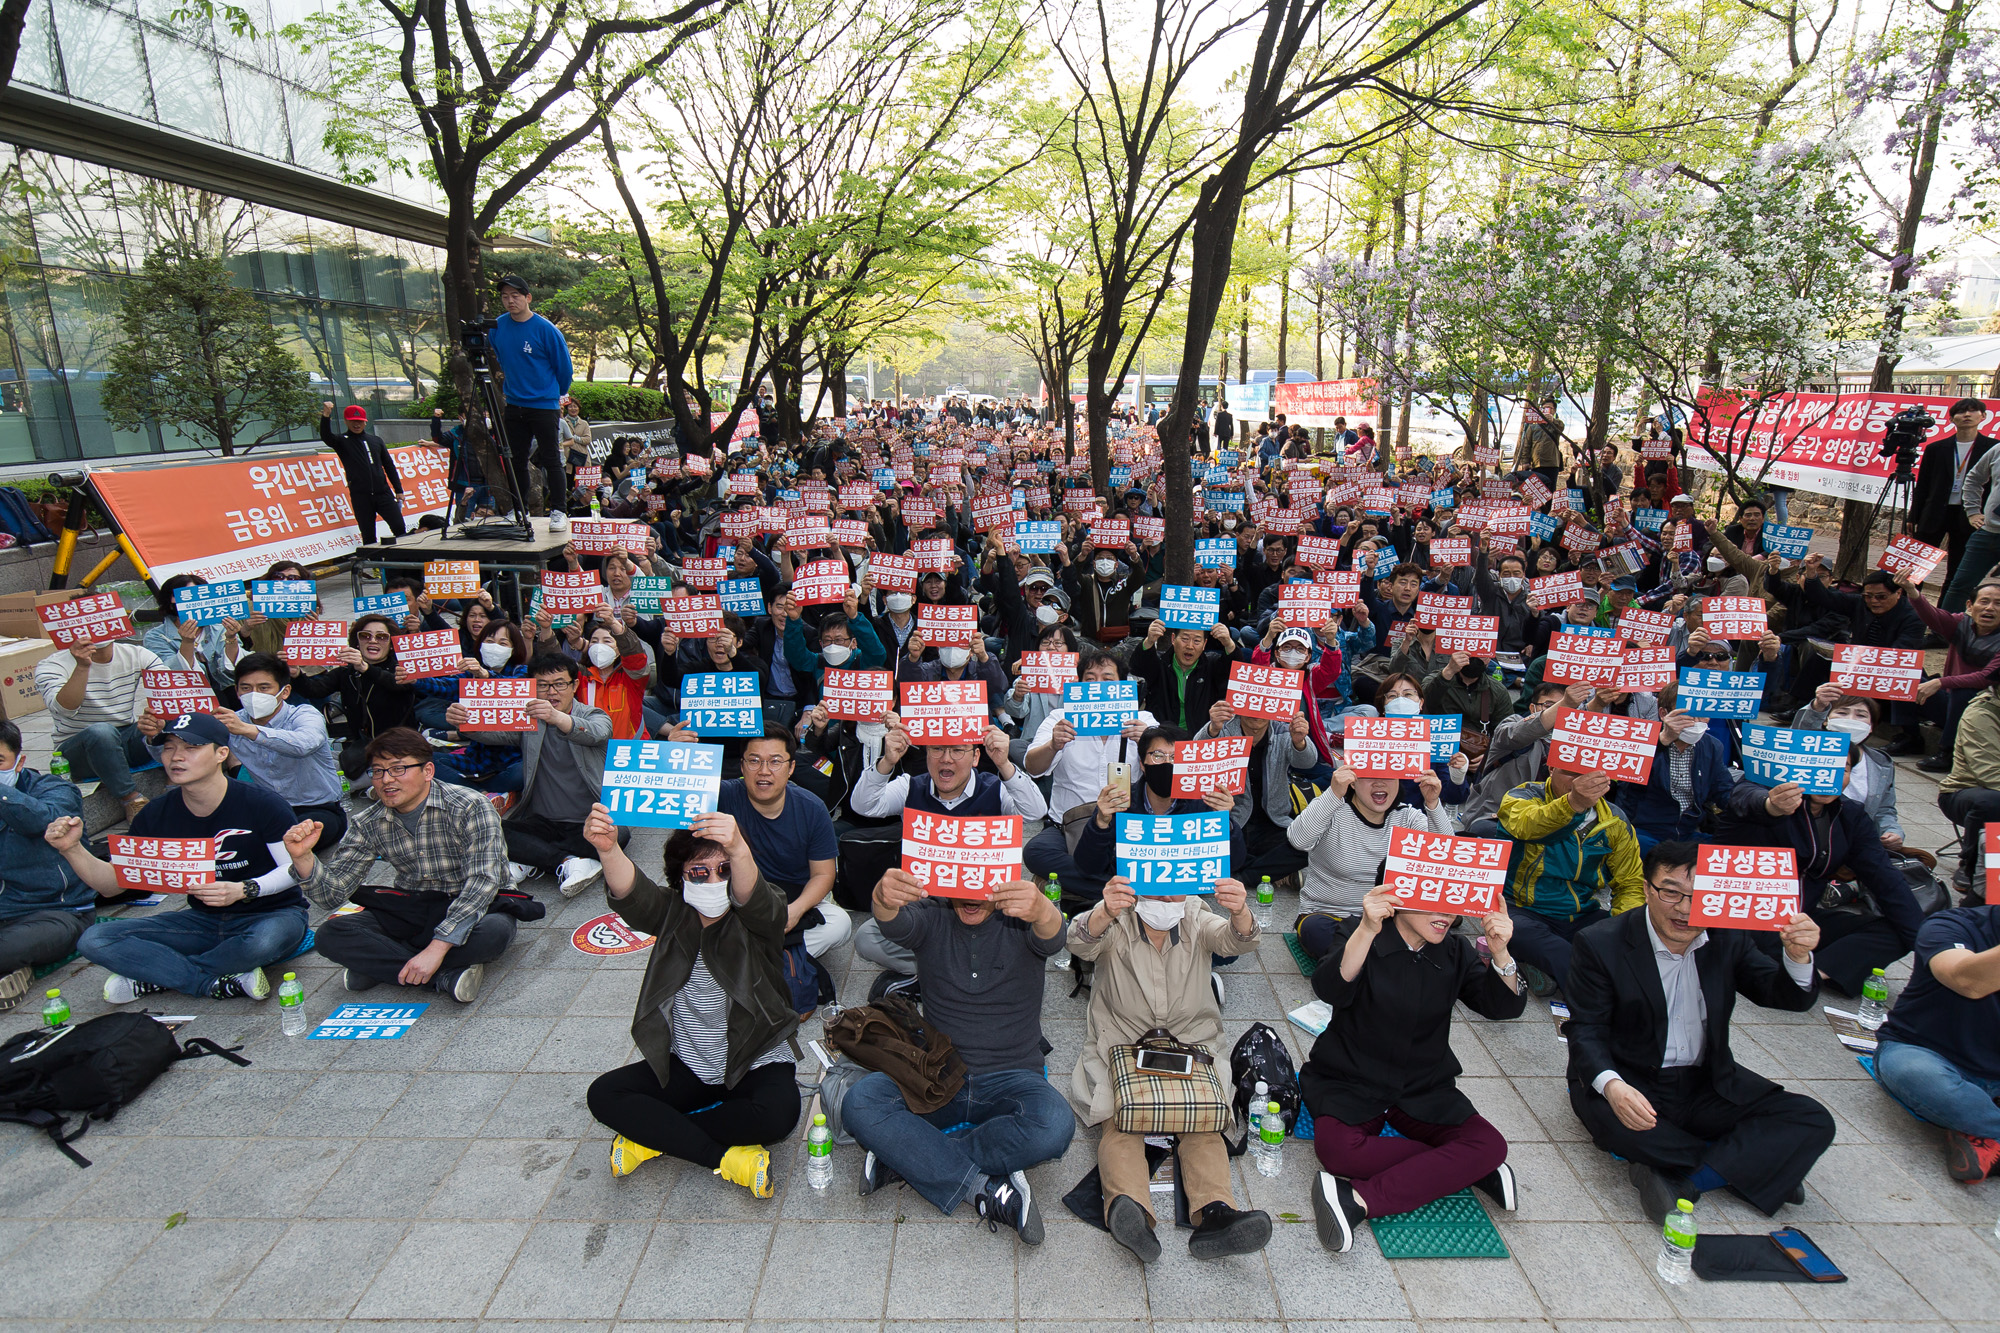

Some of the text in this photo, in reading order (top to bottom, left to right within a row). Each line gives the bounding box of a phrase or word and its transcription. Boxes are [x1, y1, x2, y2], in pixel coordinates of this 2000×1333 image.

[523, 341, 532, 353] LA
[1792, 435, 1892, 471] 즉각 영업정지
[250, 458, 345, 499] 우간다보다
[301, 493, 354, 530] 금감원
[1029, 522, 1038, 531] 큰
[1041, 522, 1057, 532] 위조
[1020, 539, 1056, 548] 112조원
[1301, 536, 1337, 549] 삼성증권
[215, 560, 247, 577] 112조원
[246, 552, 280, 570] 위조주식
[428, 562, 474, 574] 사기주식
[871, 552, 914, 570] 삼성증권
[1298, 552, 1334, 565] 영업정지
[256, 581, 311, 593] 통 큰 위조
[428, 582, 476, 594] 삼성증권
[544, 572, 596, 587] 삼성증권
[1532, 572, 1576, 588] 삼성증권
[179, 582, 240, 601] 통 큰 위조
[1164, 587, 1215, 603] 통 큰 위조
[1283, 585, 1329, 599] 삼성증권
[41, 594, 115, 620] 삼성증권
[259, 601, 311, 612] 112조원
[546, 595, 598, 609] 영업정지
[663, 596, 717, 611] 삼성증권
[1708, 598, 1764, 610] 삼성증권
[186, 603, 243, 621] 112조원
[921, 606, 971, 620] 삼성증권
[1164, 609, 1213, 624] 112조원
[1283, 608, 1329, 622] 영업정지
[53, 618, 125, 644] 영업정지
[287, 623, 338, 635] 삼성증권
[668, 619, 720, 632] 영업정지
[1441, 615, 1493, 630] 삼성증권
[1709, 621, 1765, 634] 영업정지
[395, 630, 452, 651] 삼성증권
[919, 628, 972, 642] 영업정지
[1438, 636, 1491, 652] 영업정지
[283, 646, 340, 659] 영업정지
[1554, 635, 1623, 656] 삼성증권
[401, 654, 456, 674] 영업정지
[1840, 646, 1917, 667] 삼성증권
[146, 672, 204, 687] 삼성증권
[824, 670, 886, 689] 삼성증권
[1236, 664, 1298, 688] 삼성증권
[1550, 661, 1615, 683] 영업정지
[1685, 670, 1760, 689] 통 큰 위조
[463, 680, 528, 696] 삼성증권
[685, 675, 751, 695] 통 큰 위조
[905, 683, 979, 702] 삼성증권
[1069, 683, 1133, 700] 통 큰 위조
[152, 697, 213, 714] 영업정지
[824, 698, 885, 715] 영업정지
[1229, 690, 1295, 717] 영업정지
[1683, 696, 1754, 713] 112조원
[173, 715, 191, 729] B
[464, 708, 529, 725] 영업정지
[684, 709, 753, 728] 112조원
[1562, 710, 1652, 742] 삼성증권
[905, 717, 982, 737] 영업정지
[1351, 719, 1423, 738] 삼성증권
[1183, 738, 1246, 760] 삼성증권
[1748, 727, 1842, 755] 통 큰 위조
[611, 743, 713, 773] 통 큰 위조
[1350, 750, 1422, 771] 영업정지
[1555, 742, 1643, 776] 영업정지
[1750, 760, 1835, 788] 112조원
[606, 788, 706, 816] 112조원
[906, 815, 1012, 847] 삼성증권
[1124, 816, 1222, 841] 통 큰 위조
[114, 838, 205, 859] 삼성증권
[1398, 832, 1502, 867] 삼성증권
[1127, 859, 1221, 883] 112조원
[1706, 848, 1797, 877] 삼성증권
[120, 869, 204, 890] 영업정지
[1391, 873, 1493, 909] 영업정지
[1701, 891, 1798, 923] 영업정지
[336, 1008, 415, 1018] 112조원
[316, 1027, 354, 1037] 위조
[995, 1183, 1013, 1205] N
